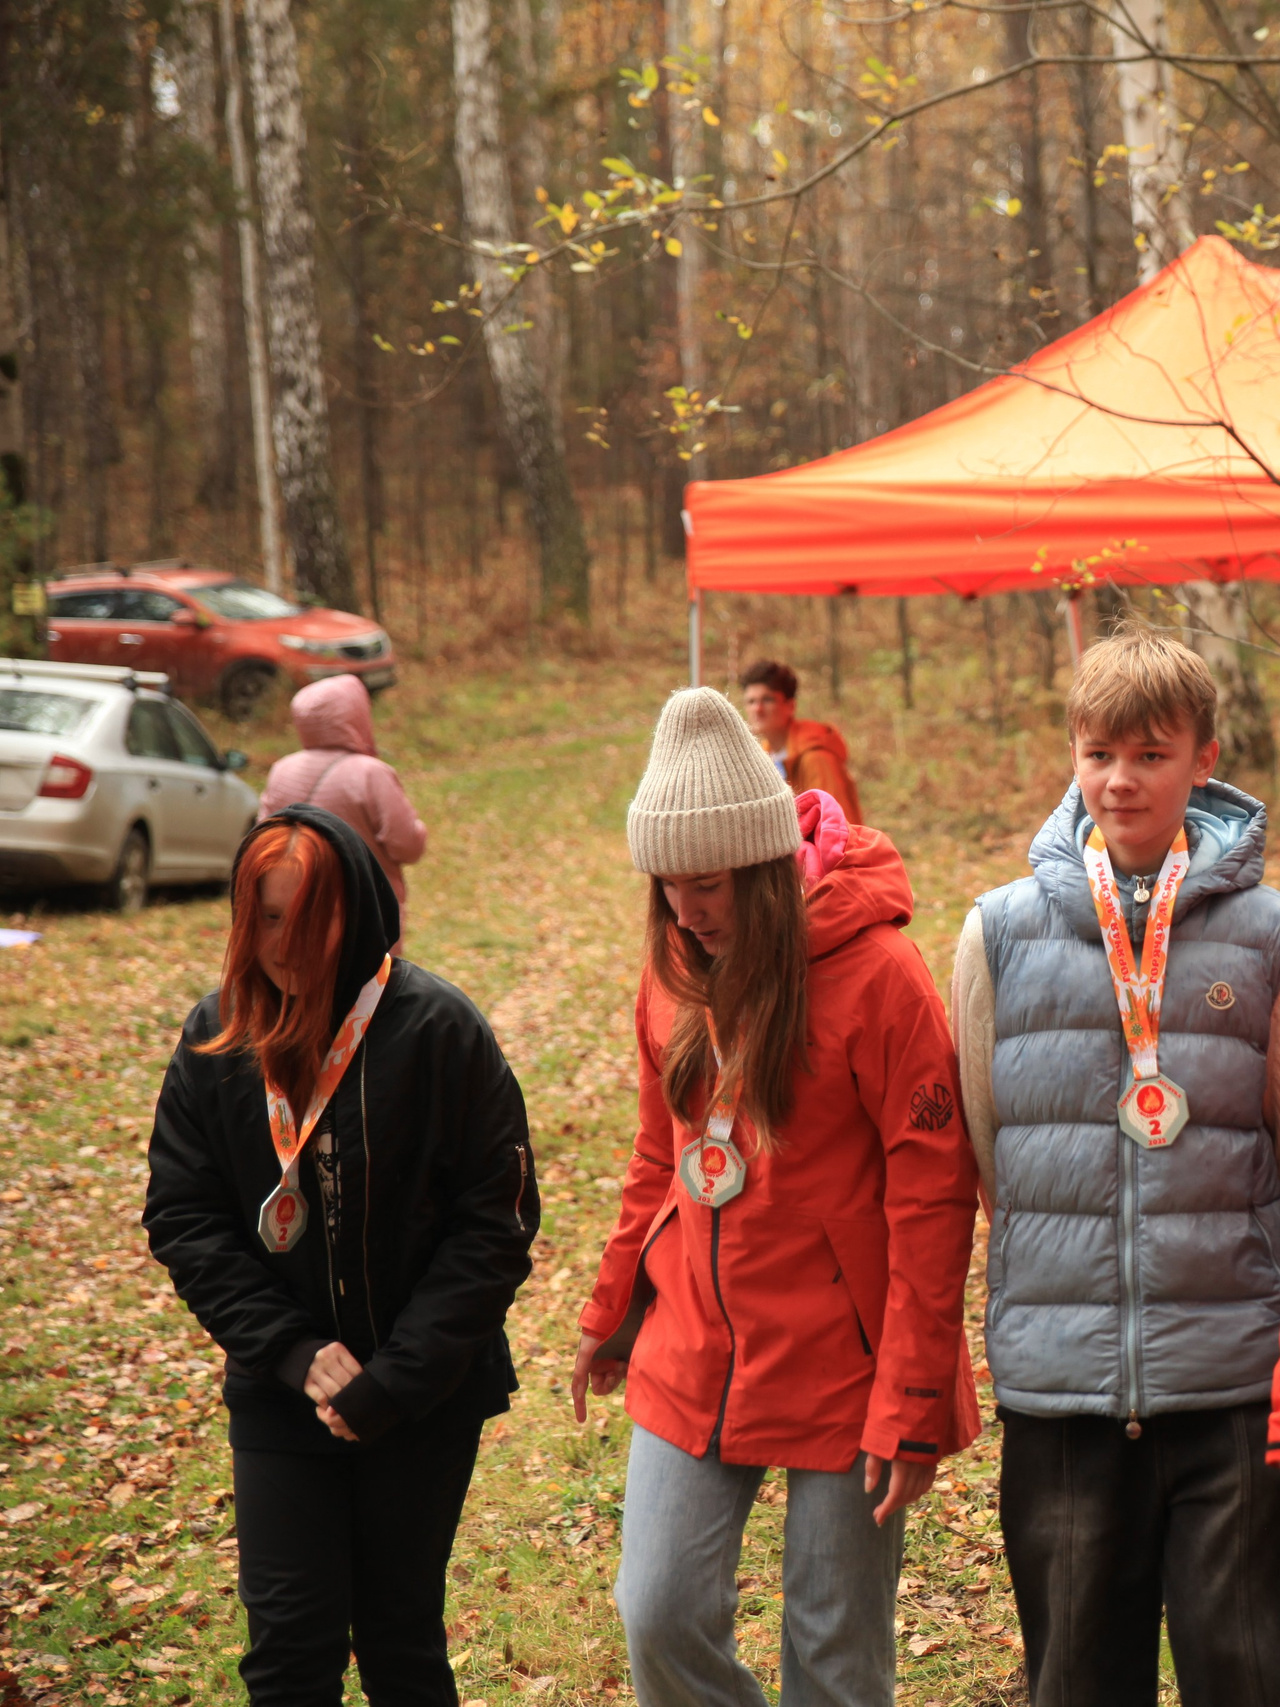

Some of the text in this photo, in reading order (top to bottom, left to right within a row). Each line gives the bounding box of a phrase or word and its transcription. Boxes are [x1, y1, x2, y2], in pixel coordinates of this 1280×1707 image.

[1095, 862, 1117, 916] ДЕСЯТКА
[1149, 922, 1164, 984] ГОРЯЧАЯ
[1158, 864, 1182, 916] ДЕСЯТКА
[1111, 921, 1131, 983] ГОРЯЧАЯ
[1149, 1119, 1162, 1136] 2
[702, 1178, 715, 1194] 2
[278, 1226, 288, 1242] 2
